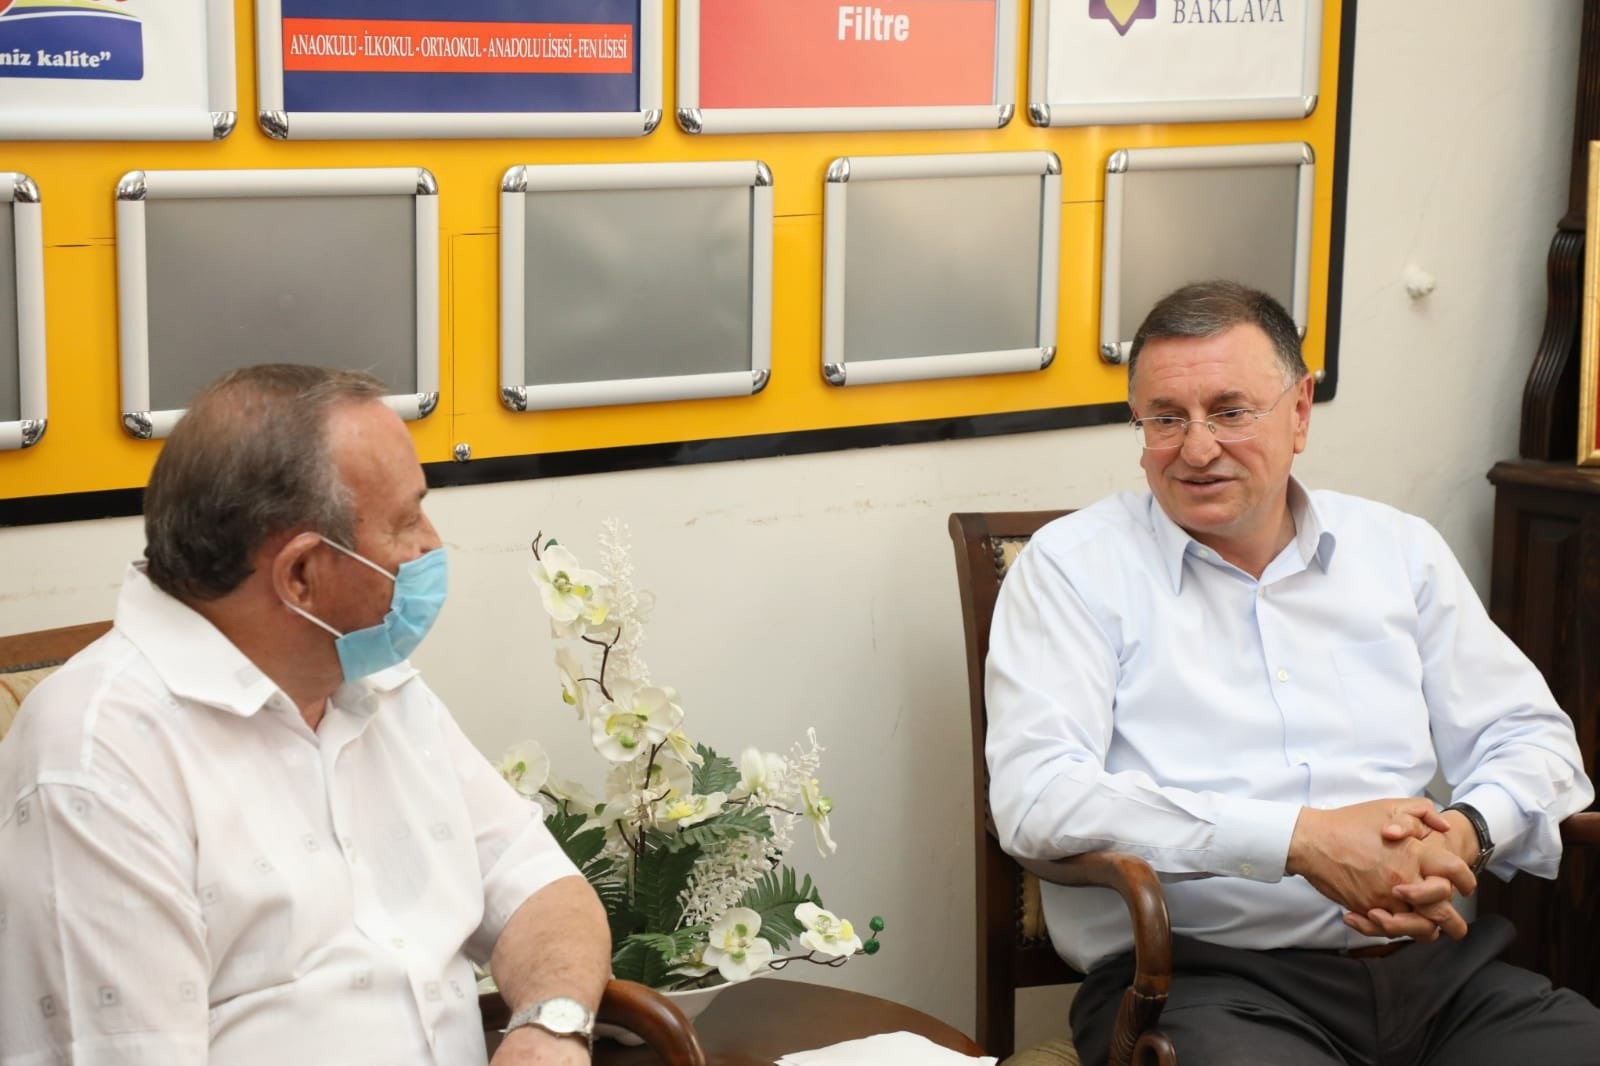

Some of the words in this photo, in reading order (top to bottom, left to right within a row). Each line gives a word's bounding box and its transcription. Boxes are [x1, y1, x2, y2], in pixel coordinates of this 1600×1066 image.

[837, 6, 910, 41] Filtre
[1172, 0, 1284, 23] BAKLAVA
[290, 34, 358, 56] ANAOKULU
[364, 29, 414, 57] İLKOKUL
[421, 36, 482, 57] ORTAOKUL
[488, 37, 541, 58] ANADOLU
[542, 32, 573, 58] LİSESİ
[578, 38, 597, 58] FEN
[598, 33, 627, 59] LİSESİ
